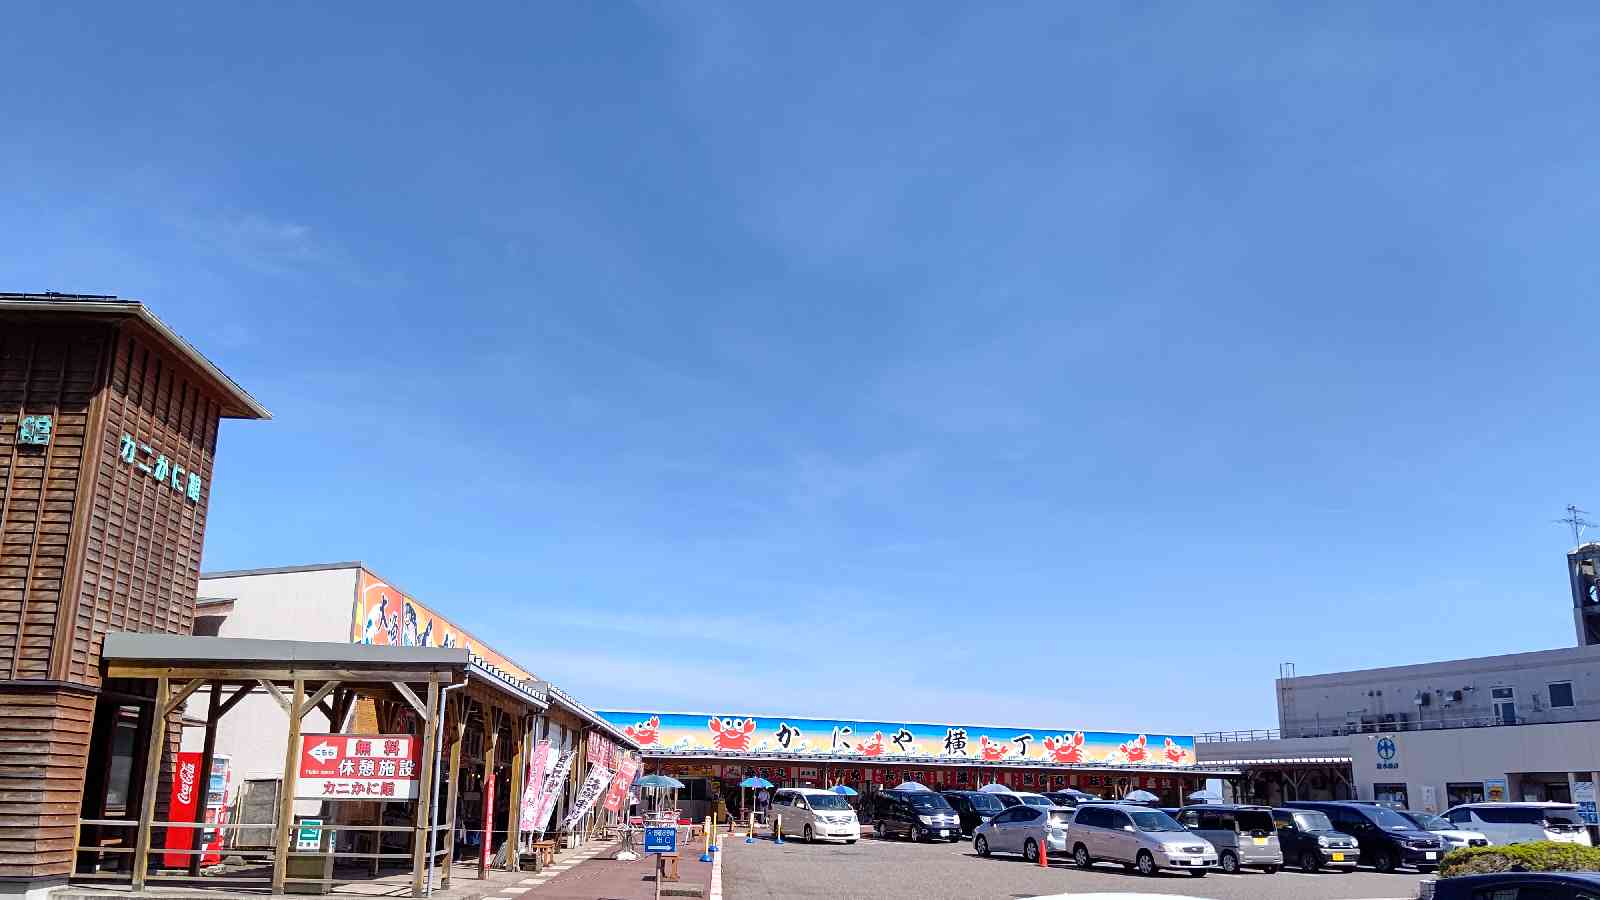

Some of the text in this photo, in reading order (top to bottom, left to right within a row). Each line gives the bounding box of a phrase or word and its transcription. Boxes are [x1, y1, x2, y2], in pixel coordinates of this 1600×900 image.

[119, 433, 202, 503] カニかに館
[355, 739, 401, 757] 無料
[775, 723, 1033, 756] かにや横丁
[338, 759, 415, 777] 休憩施設
[177, 761, 196, 804] Coca-Cola
[322, 781, 396, 797] カニかに館
